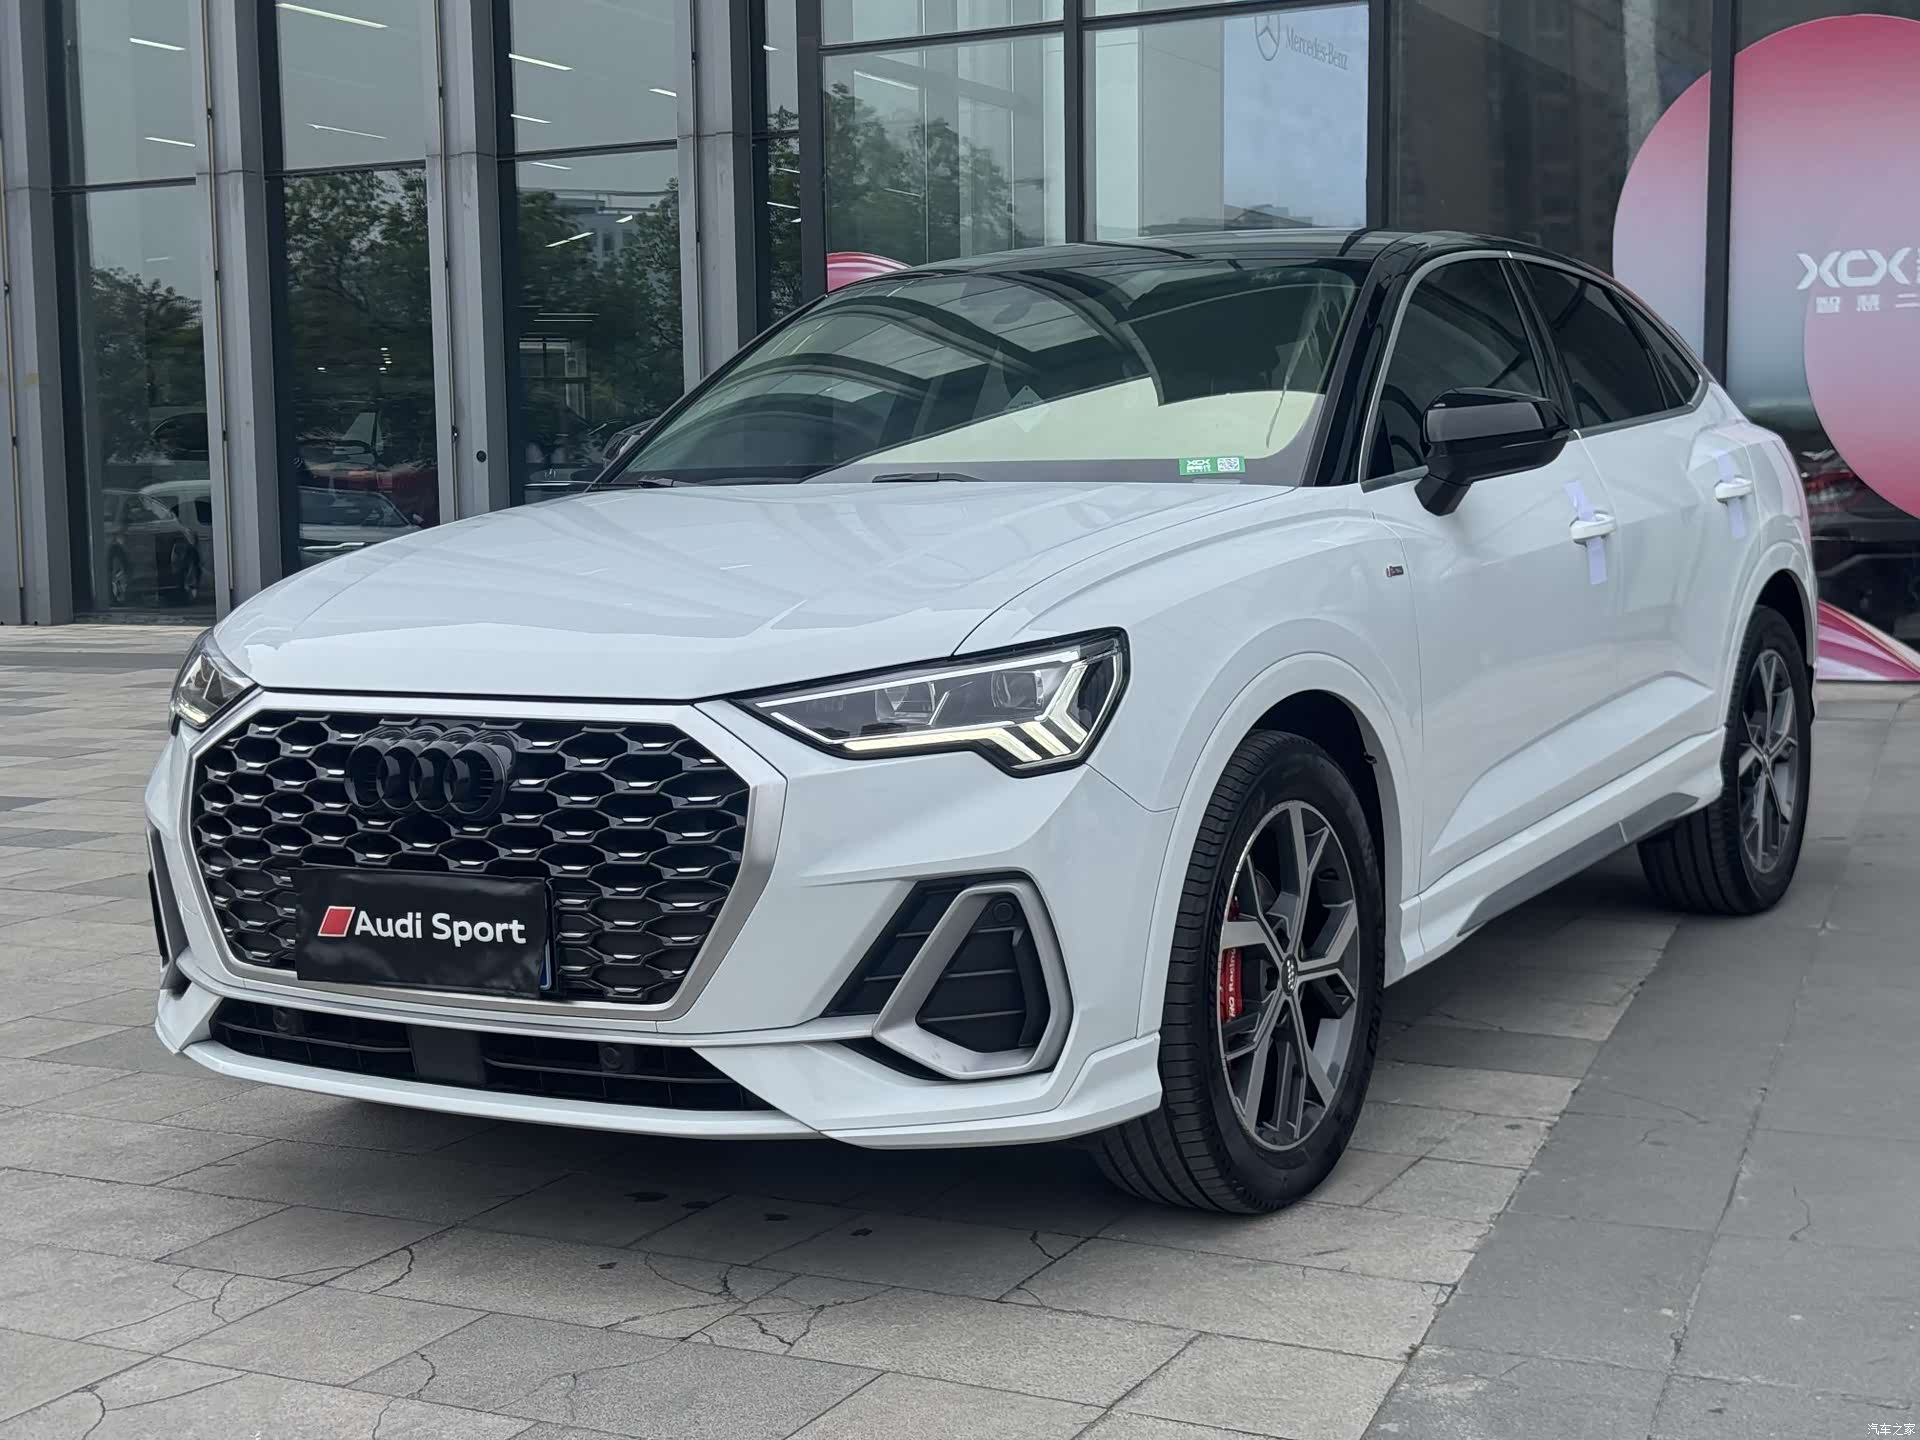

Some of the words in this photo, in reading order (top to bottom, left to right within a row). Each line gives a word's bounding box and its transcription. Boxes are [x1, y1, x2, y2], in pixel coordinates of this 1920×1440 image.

[1286, 24, 1349, 70] Mercedes-Benz
[354, 910, 423, 939] Audi
[431, 912, 527, 947] Sport
